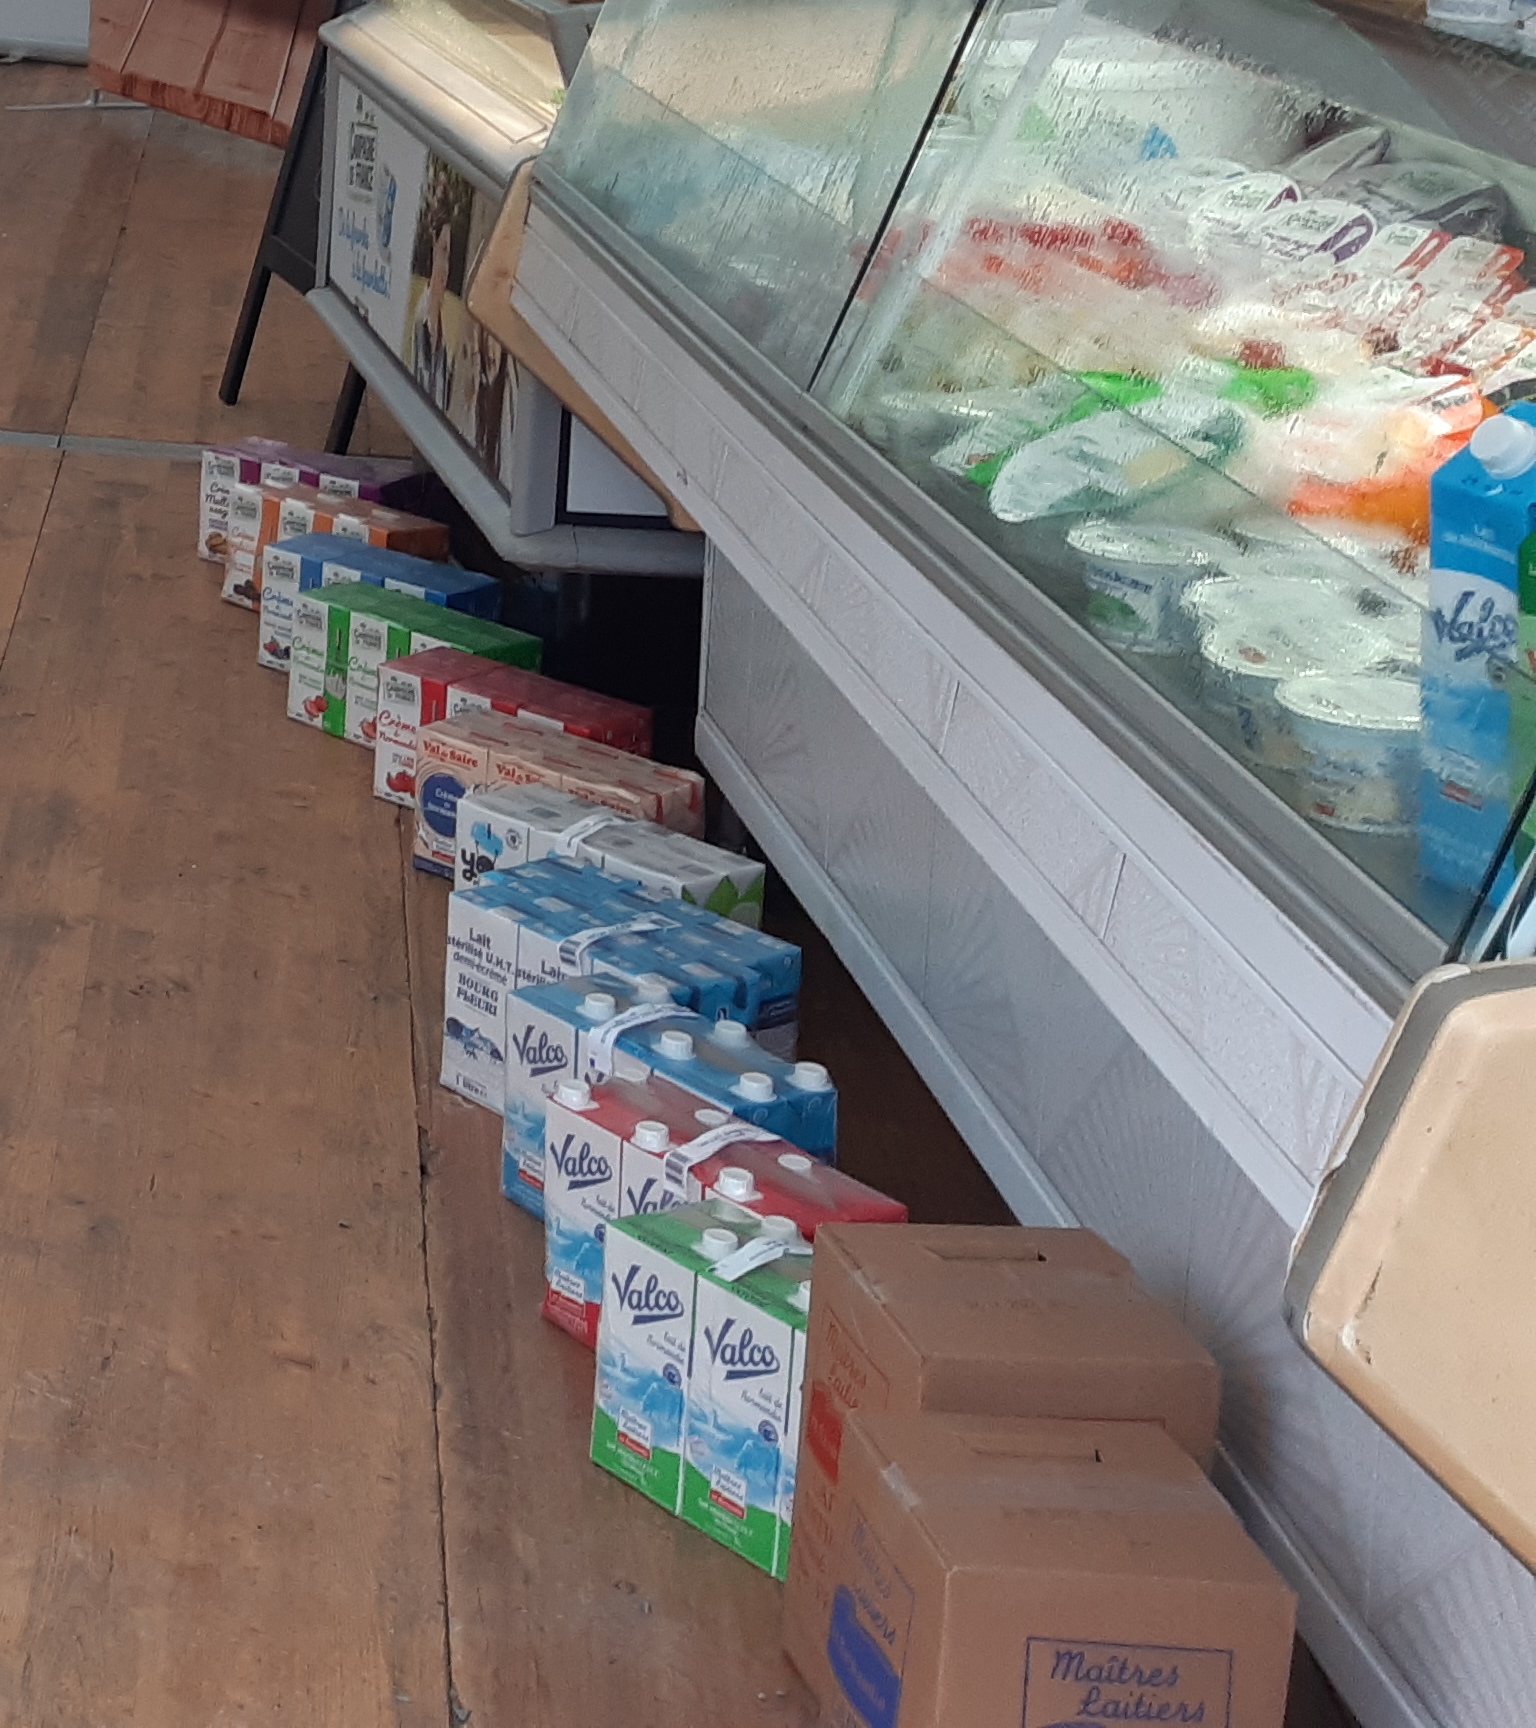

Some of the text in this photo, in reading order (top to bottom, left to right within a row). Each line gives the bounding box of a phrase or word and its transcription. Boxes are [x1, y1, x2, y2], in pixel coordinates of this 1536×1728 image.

[378, 709, 417, 734] Crème
[423, 740, 440, 756] Val
[449, 750, 479, 769] Saire
[469, 926, 491, 949] Lait
[458, 972, 499, 1003] BOURG
[512, 1024, 568, 1072] Valco
[550, 1133, 612, 1184] Valco
[612, 1264, 685, 1320] Valco
[704, 1318, 780, 1373] Valco
[1051, 1649, 1179, 1687] Maîtres
[1076, 1685, 1204, 1722] Laitiers
